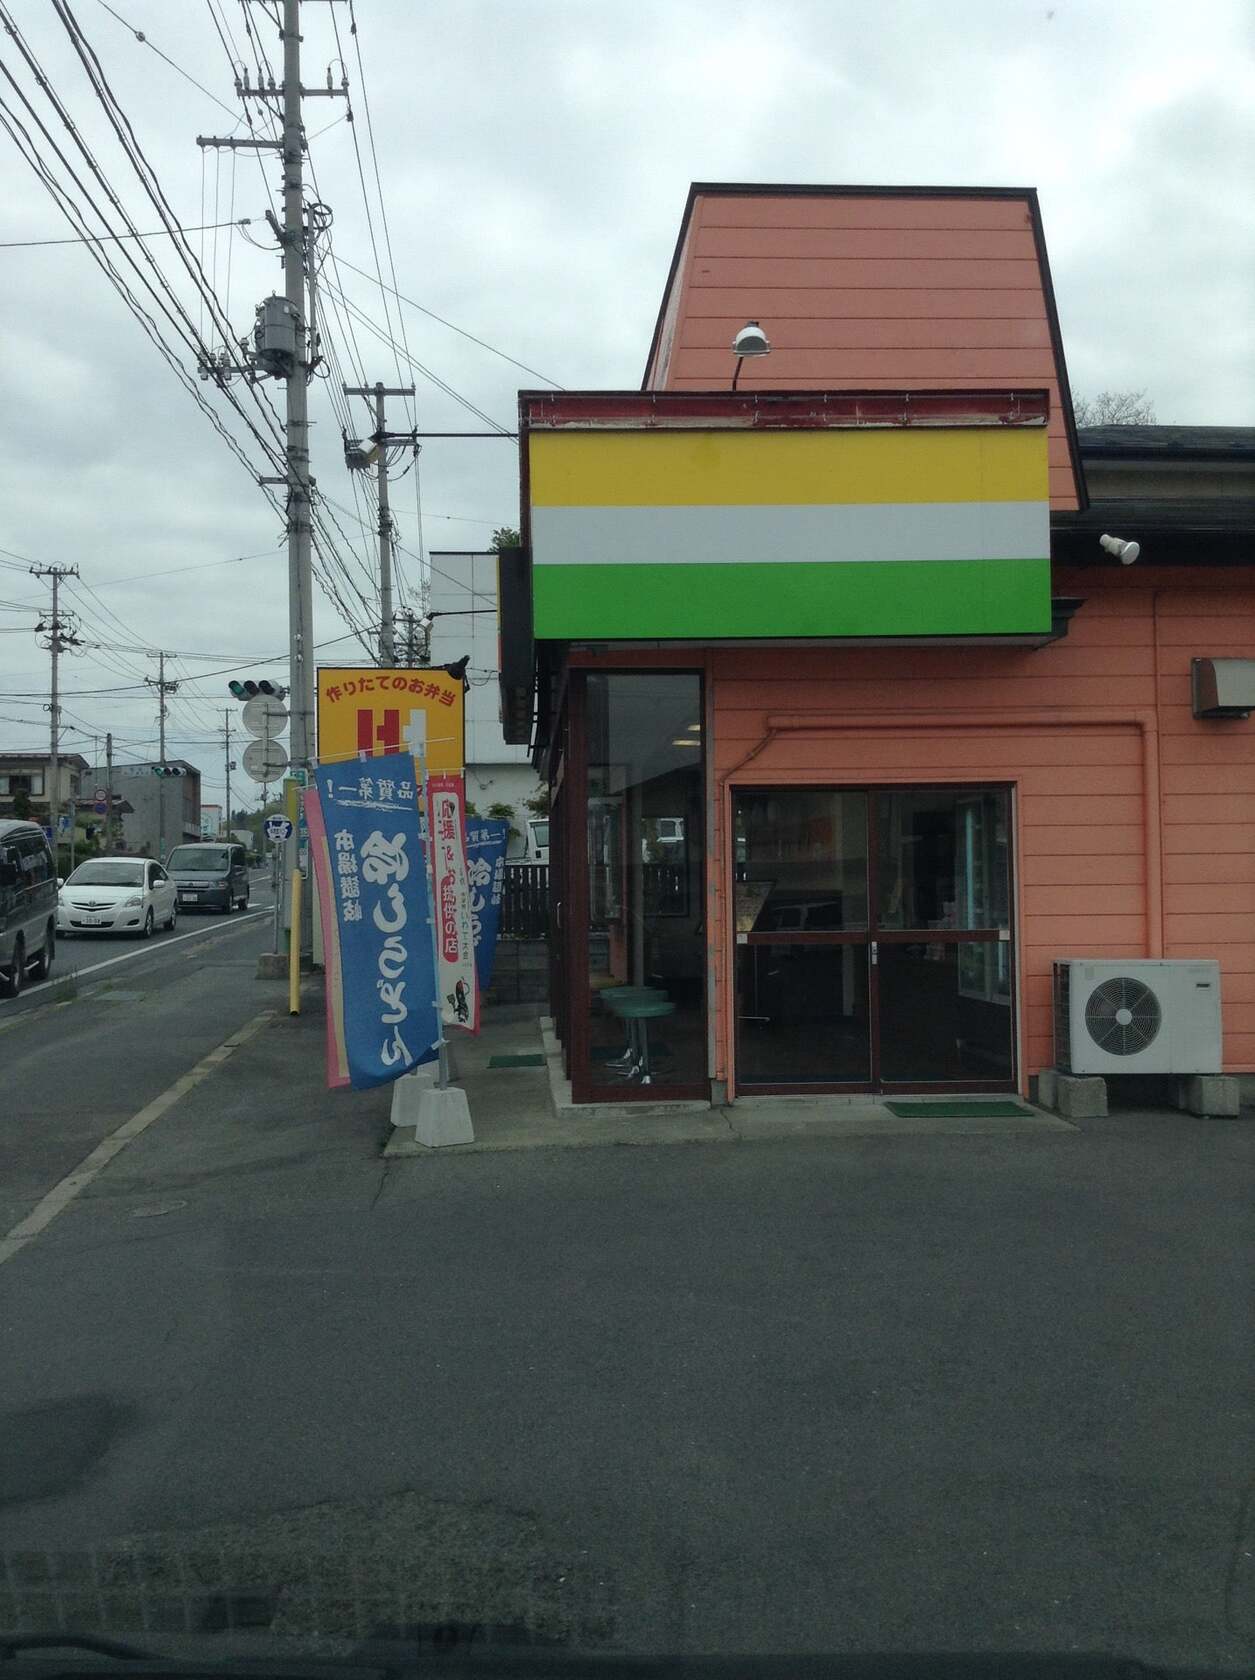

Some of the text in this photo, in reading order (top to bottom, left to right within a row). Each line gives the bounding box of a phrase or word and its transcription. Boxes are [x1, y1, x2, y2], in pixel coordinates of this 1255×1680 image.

[326, 675, 457, 708] 作りたてのお弁当
